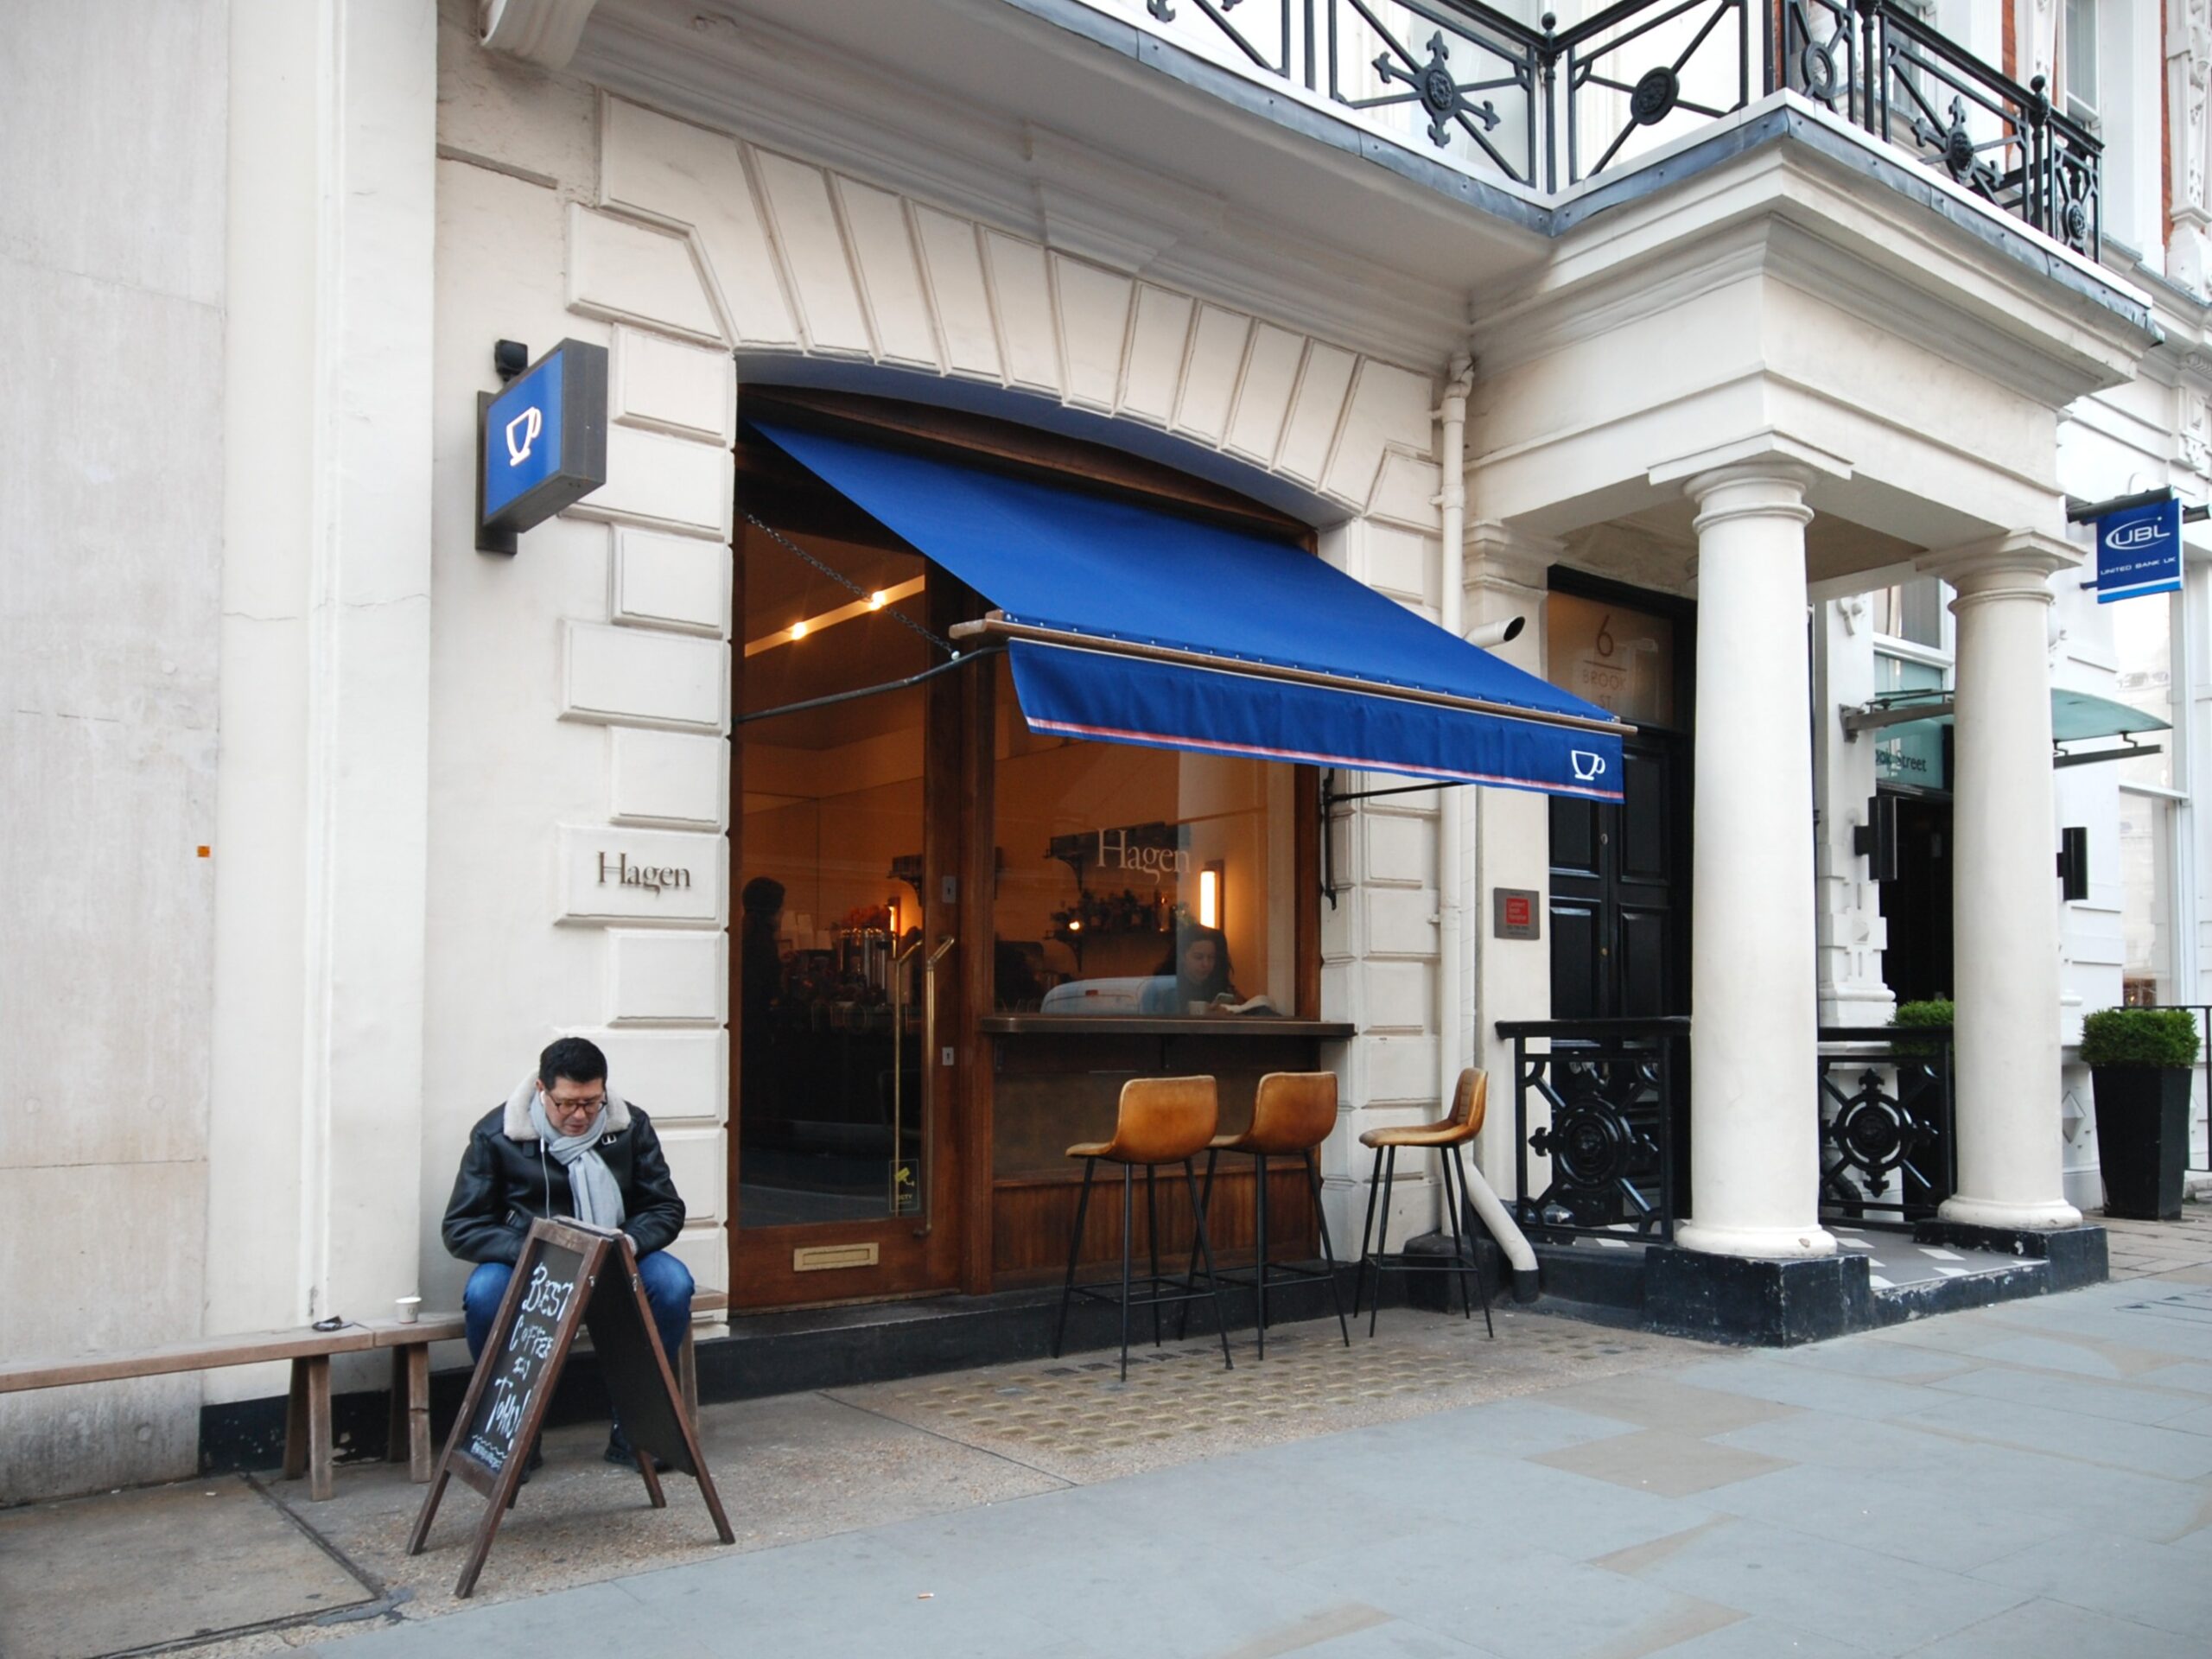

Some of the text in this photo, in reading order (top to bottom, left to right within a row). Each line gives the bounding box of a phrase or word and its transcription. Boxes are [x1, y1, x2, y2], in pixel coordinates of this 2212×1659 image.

[2114, 524, 2171, 545] UBL
[2100, 556, 2177, 575] UNITED BANK UK
[1596, 614, 1614, 657] 6
[1582, 668, 1627, 692] BROOK
[1893, 750, 1927, 772] Street
[597, 851, 691, 895] Hagen
[1096, 828, 1191, 886] Hagen
[522, 1262, 574, 1322] BEST
